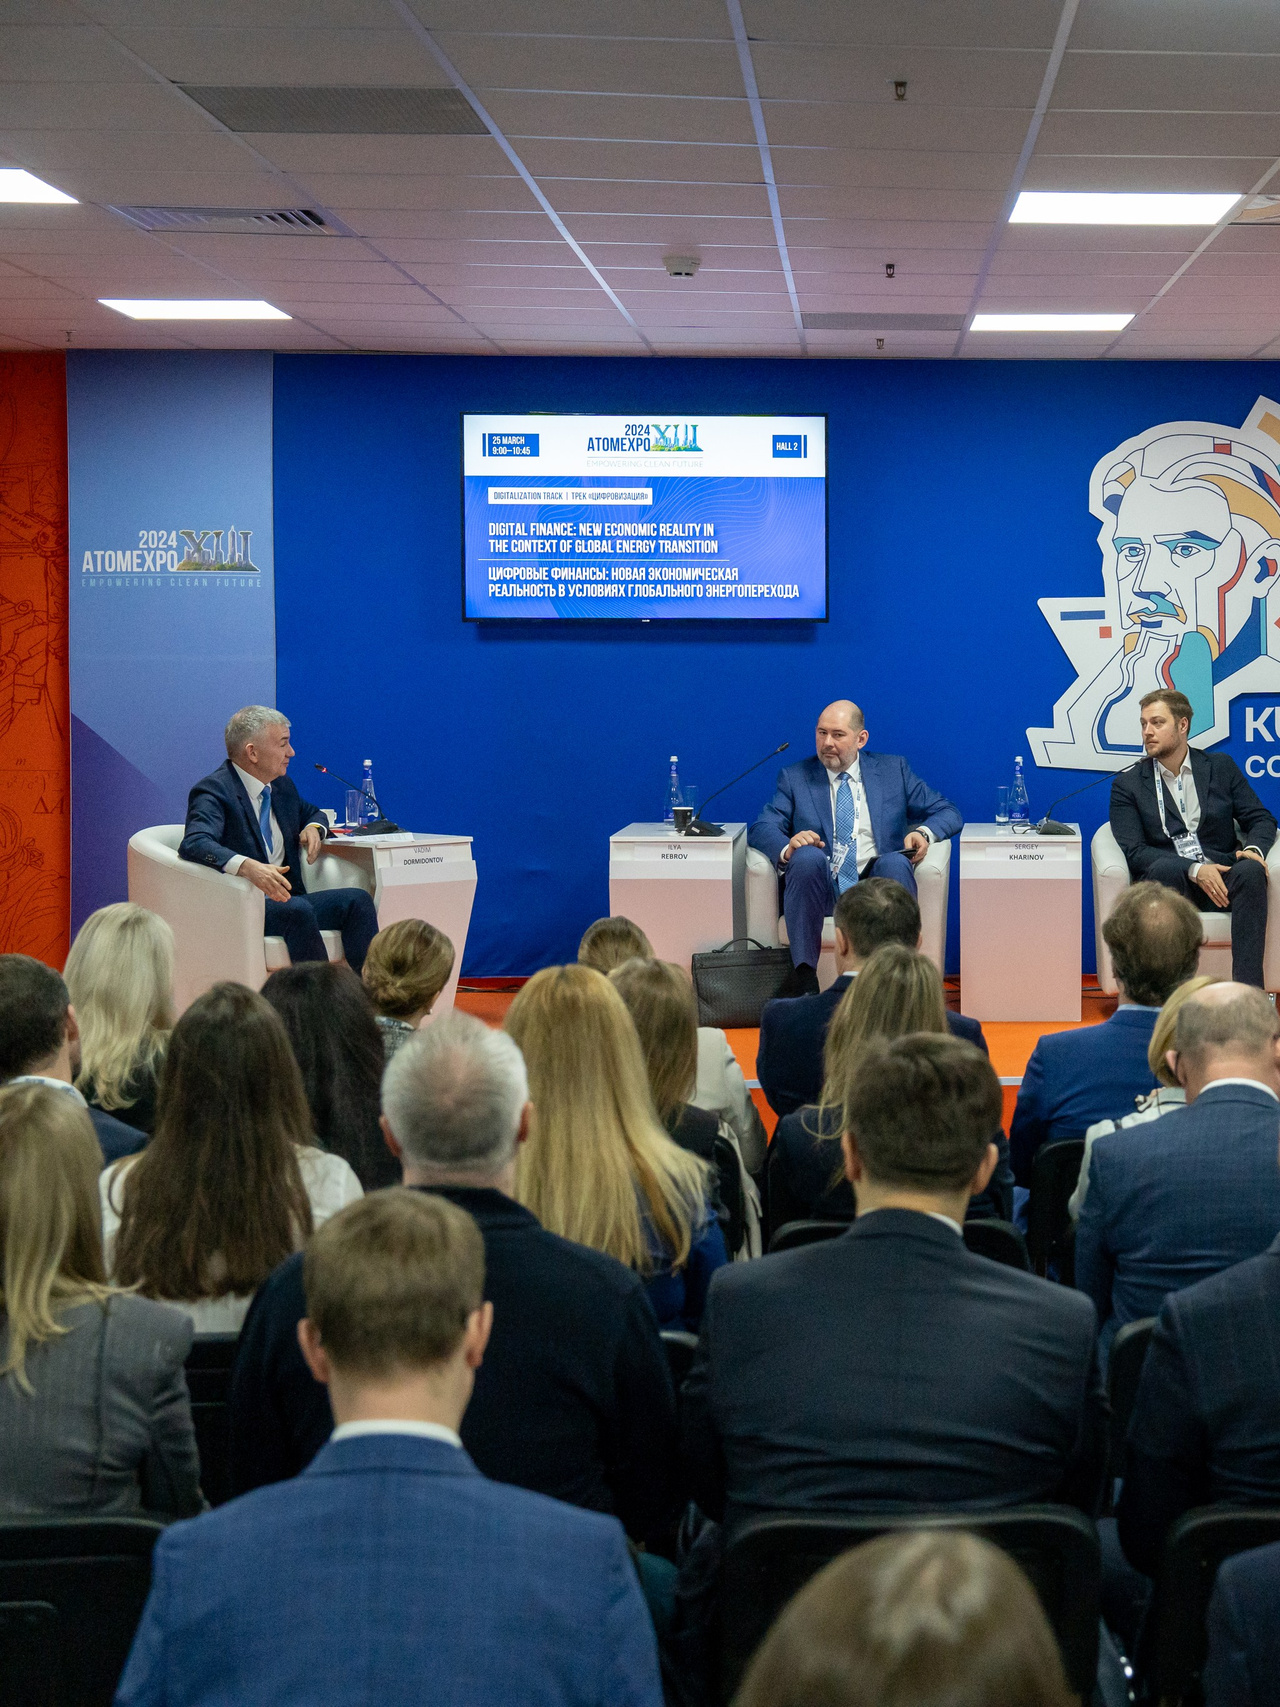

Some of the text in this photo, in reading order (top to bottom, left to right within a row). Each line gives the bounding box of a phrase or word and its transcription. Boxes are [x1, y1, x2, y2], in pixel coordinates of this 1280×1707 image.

[625, 424, 650, 437] 2024
[492, 436, 525, 445] 25 MARCH
[587, 437, 650, 452] ATOMEXPO
[776, 442, 798, 451] HALL 2
[586, 460, 703, 468] EMPOWERING CLEAN FUTURE
[493, 492, 563, 501] DIGITALIZATION TRACK
[571, 492, 587, 501] ТРЕК
[488, 522, 714, 537] DIGITAL FINANCE: NEW ECONOMIC REALITY IN
[139, 530, 178, 549] 2024
[488, 539, 718, 553] THE CONTEXT OF GLOBAL ENERGY TRANSITION
[82, 550, 178, 573] ATOMEXPO
[488, 567, 738, 582] ЦИФРОВЫЕ ФИНАНСЫ: НОВАЯ ЭКОНОМИЧЕСКАЯ
[82, 578, 261, 588] EMPOWERING CLEAN FUTURE
[488, 583, 799, 599] РЕАЛЬНОСТЬ В УСЛОВИЯХ ГЛОБАЛЬНОГО ЭНЕРГОПЕРЕХОДА
[404, 857, 443, 865] DORMIDONTOV
